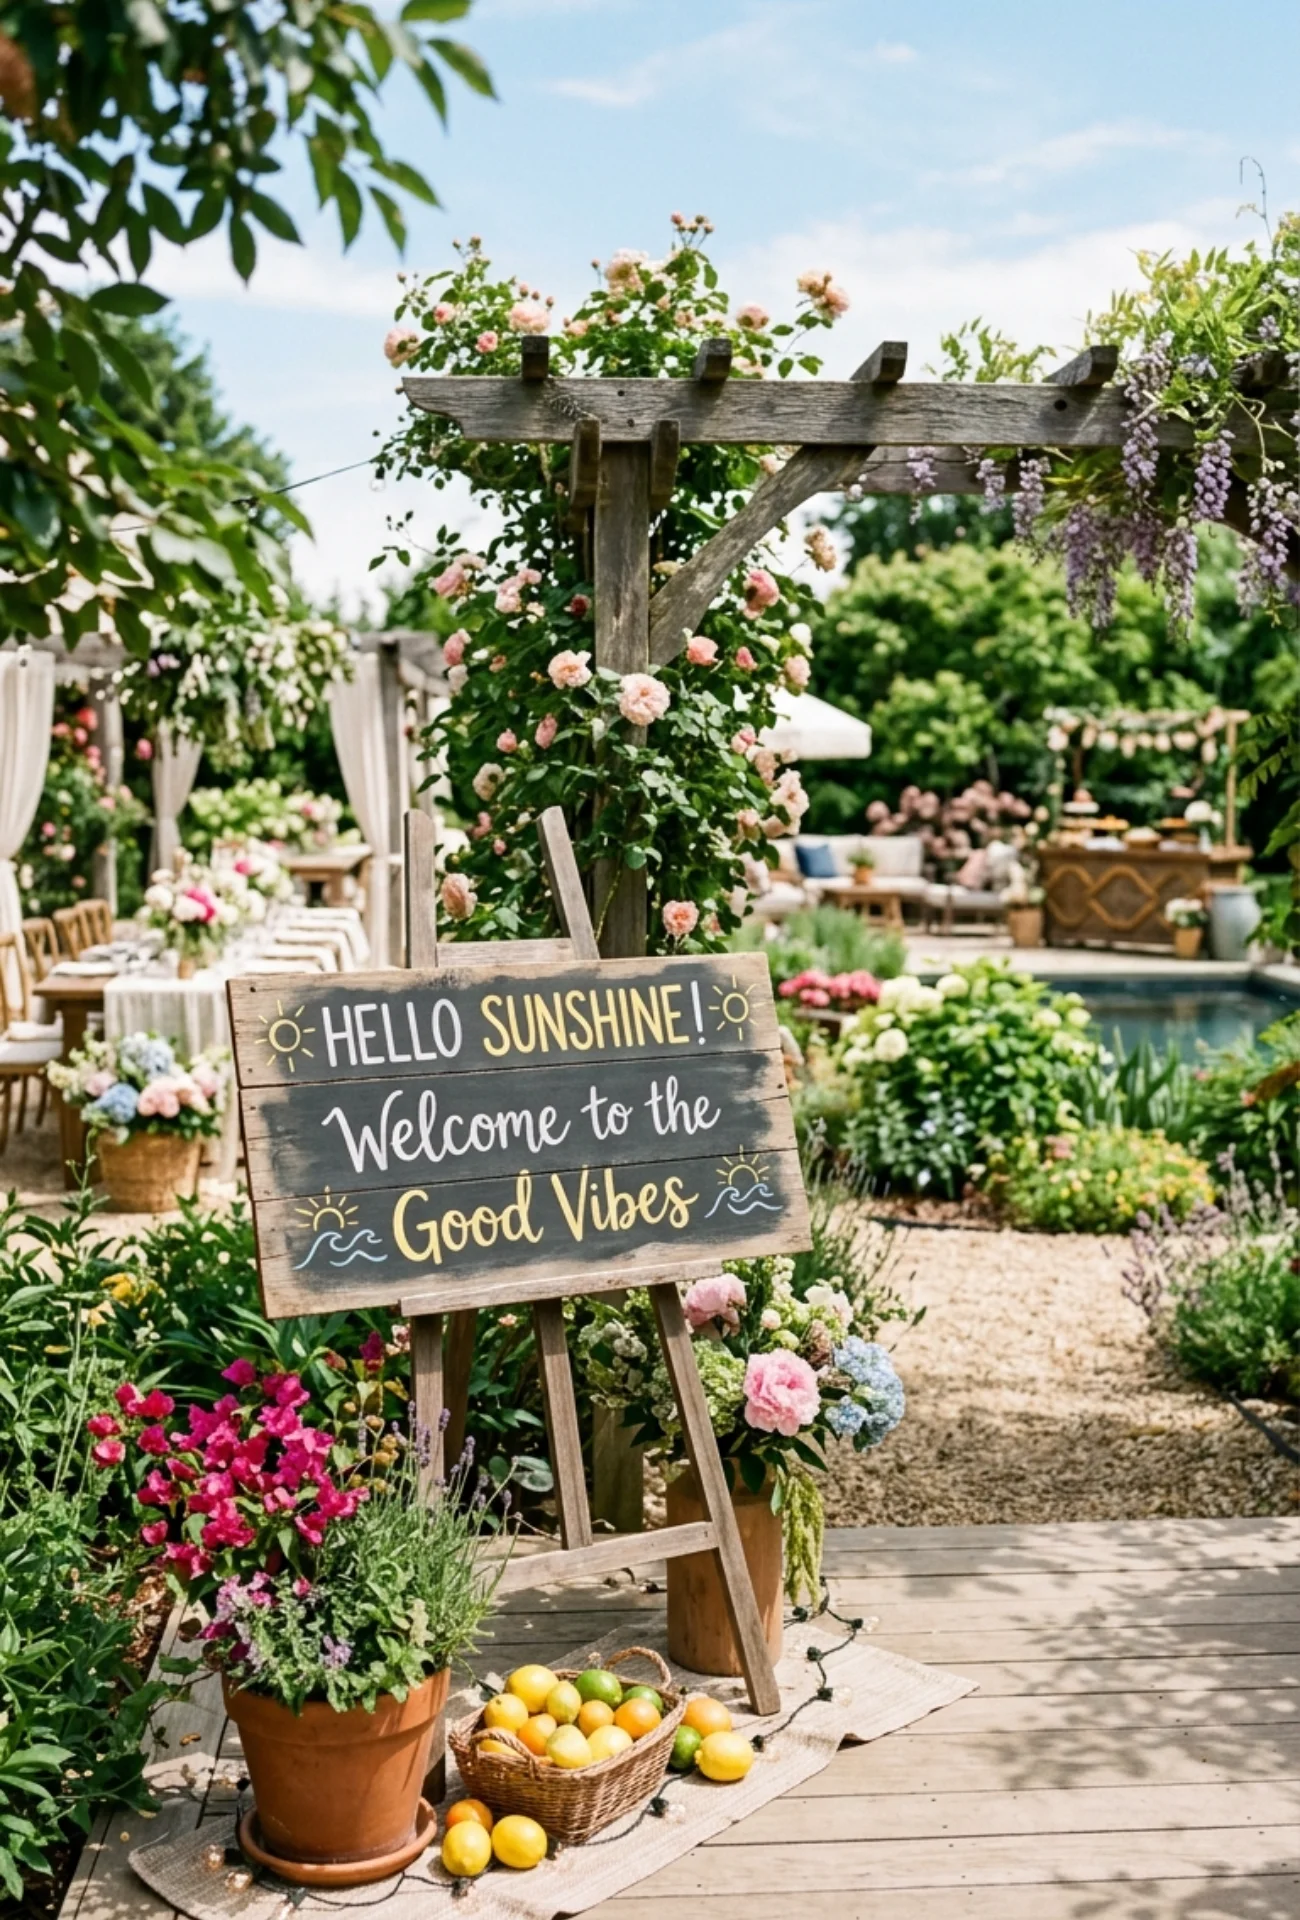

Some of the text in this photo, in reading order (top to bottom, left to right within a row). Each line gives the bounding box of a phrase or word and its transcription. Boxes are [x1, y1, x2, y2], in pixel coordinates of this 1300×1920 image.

[321, 981, 707, 1067] HELLO SUNSHINE!
[321, 1076, 721, 1174] Welcome to the
[392, 1165, 699, 1265] Good Vibes
